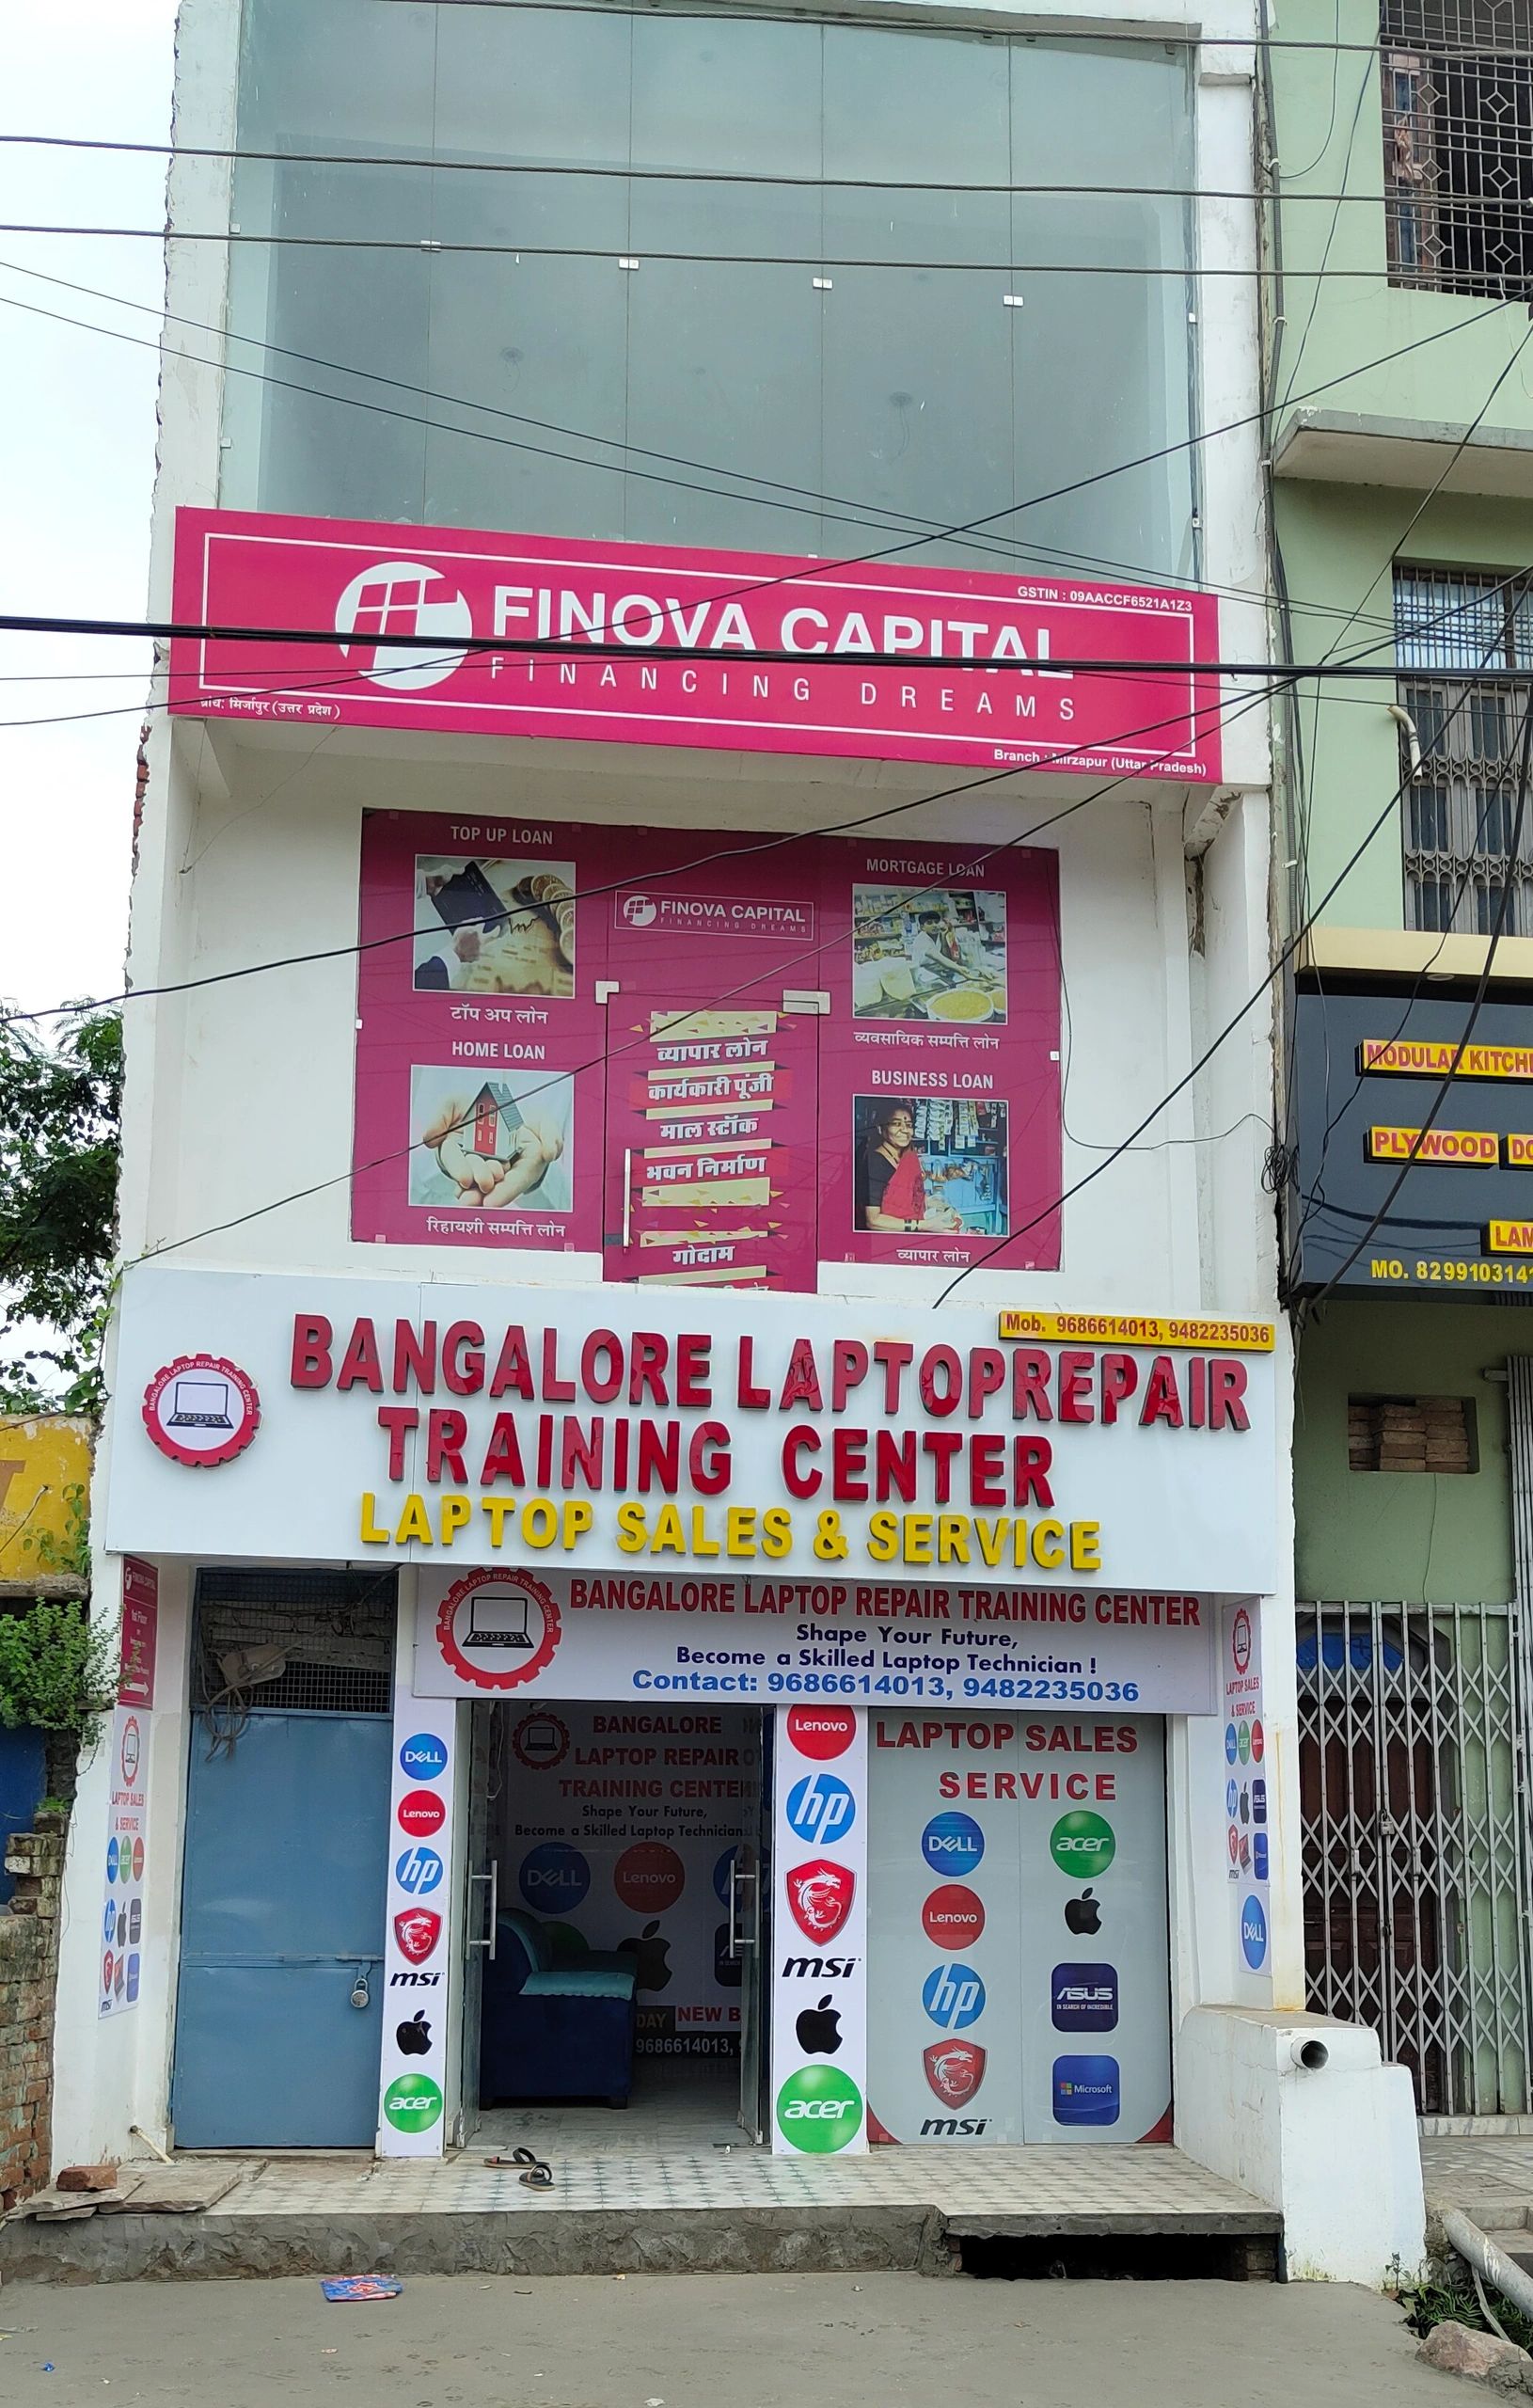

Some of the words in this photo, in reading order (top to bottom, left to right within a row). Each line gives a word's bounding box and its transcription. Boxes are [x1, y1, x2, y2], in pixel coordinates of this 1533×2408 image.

[1018, 586, 1059, 600] GSTIN
[1069, 590, 1193, 612] 09AACCF6521A1Z3
[493, 584, 756, 651] FINOVA
[780, 607, 1074, 679] CAPITAL
[491, 656, 811, 702] FINANCING
[861, 682, 1075, 721] DREAMS
[229, 696, 271, 716] मिर्जापुर
[993, 748, 1040, 764] Branch
[1051, 752, 1107, 769] Mirzapur
[1111, 757, 1146, 771] (Uttar
[1149, 761, 1207, 777] Pradesh)
[450, 825, 481, 842] TOP
[485, 827, 508, 843] UP
[511, 828, 553, 846] LOAN
[866, 858, 944, 877] MORTGAGE
[948, 863, 985, 878] LOAN
[660, 900, 727, 919] FINOVA
[731, 905, 806, 923] CAPITAL
[660, 916, 740, 930] FINANCING
[751, 922, 807, 934] DREAMS
[449, 1002, 481, 1022] टॉप
[484, 1006, 511, 1022] अप
[514, 1006, 549, 1025] लोन
[451, 1040, 499, 1059] HOME
[503, 1042, 545, 1060] LOAN
[656, 1042, 722, 1063] व्यापार
[724, 1037, 769, 1058] लोन
[927, 1032, 970, 1051] सम्पत्ति
[972, 1032, 1001, 1051] लोन
[647, 1075, 732, 1101] कार्यकारी
[871, 1069, 948, 1088] BUSINESS
[952, 1072, 994, 1089] LOAN
[659, 1121, 704, 1140] माल
[706, 1115, 760, 1136] स्टॉक
[1374, 1131, 1496, 1160] PLYWOOD
[646, 1162, 694, 1181] भवन
[697, 1153, 767, 1179] निर्माण
[426, 1216, 484, 1236] रिहायशी
[488, 1218, 533, 1237] सम्पत्ति
[537, 1219, 566, 1238] लोन
[672, 1244, 736, 1265] गोदाम
[895, 1247, 940, 1263] व्यापार
[942, 1246, 972, 1263] लोन
[1370, 1259, 1409, 1280] MO.
[1006, 1313, 1046, 1332] Mob.
[1056, 1315, 1164, 1341] 9686614013,
[1168, 1321, 1271, 1344] 9482235036
[291, 1314, 712, 1409] BANGALORE
[149, 1374, 171, 1412] BANGALORE
[169, 1361, 195, 1377] LAPTOP
[196, 1360, 221, 1370] REPAIR
[221, 1366, 246, 1390] TRAINING
[242, 1389, 253, 1417] CENTER
[377, 1406, 733, 1496] TRAINING
[781, 1423, 1055, 1509] CENTER
[359, 1492, 593, 1551] LAPTOP
[615, 1501, 794, 1560] SALES
[813, 1509, 849, 1561] &
[866, 1510, 1103, 1573] SERVICE
[443, 1590, 466, 1632] BANGALORE
[466, 1574, 491, 1591] LAPTOP
[493, 1573, 519, 1583] REPAIR
[518, 1578, 546, 1605] TRAINING
[543, 1602, 555, 1634] CENTER
[570, 1577, 735, 1614] BANGALORE
[744, 1583, 847, 1617] LAPTOP
[856, 1585, 950, 1620] REPAIR
[958, 1589, 1086, 1624] TRAINING
[1095, 1593, 1201, 1627] CENTER
[796, 1624, 867, 1647] Shape
[878, 1626, 932, 1645] Your
[941, 1628, 1019, 1651] Future,
[676, 1646, 766, 1667] Become
[776, 1651, 791, 1667] a
[798, 1648, 876, 1669] Skilled
[882, 1651, 961, 1675] Laptop
[967, 1654, 1083, 1674] Technician
[1089, 1657, 1098, 1675] !
[631, 1669, 758, 1693] Contact:
[767, 1671, 954, 1702] 9686614013,
[963, 1678, 1140, 1703] 9482235036
[1244, 1676, 1259, 1691] SALES
[1236, 1700, 1256, 1718] SERVICE
[593, 1715, 722, 1735] BANGALORE
[795, 1718, 848, 1733] Lenovo
[876, 1720, 1015, 1751] LAPTOP
[1025, 1724, 1138, 1753] SALES
[404, 1751, 443, 1764] DELL
[575, 1747, 657, 1766] LAPTOP
[664, 1747, 739, 1766] REPAIR
[558, 1779, 662, 1798] TRAINING
[939, 1771, 1117, 1801] SERVICE
[403, 1809, 440, 1819] Lenovo
[581, 1804, 623, 1820] Shape
[628, 1805, 658, 1818] Your
[664, 1805, 708, 1821] Future,
[514, 1824, 565, 1837] Become
[571, 1827, 578, 1837] a
[583, 1824, 626, 1837] Skilled
[630, 1825, 675, 1840] Laptop
[678, 1825, 743, 1837] Technician
[928, 1835, 978, 1852] DELL
[1055, 1836, 1110, 1853] acer
[527, 1868, 582, 1887] DELL
[623, 1872, 676, 1884] Lenovo
[929, 1910, 978, 1925] Lenovo
[1243, 1921, 1264, 1943] DELL
[782, 1956, 857, 1979] msi
[389, 1972, 441, 1987] msi
[1056, 1987, 1114, 2001] ASUS
[677, 2006, 722, 2022] NEW
[636, 2037, 734, 2056] 9686614013,
[1073, 2083, 1113, 2095] Microsoft
[388, 2096, 438, 2111] acer
[783, 2099, 855, 2120] acer
[919, 2117, 988, 2137] msi
